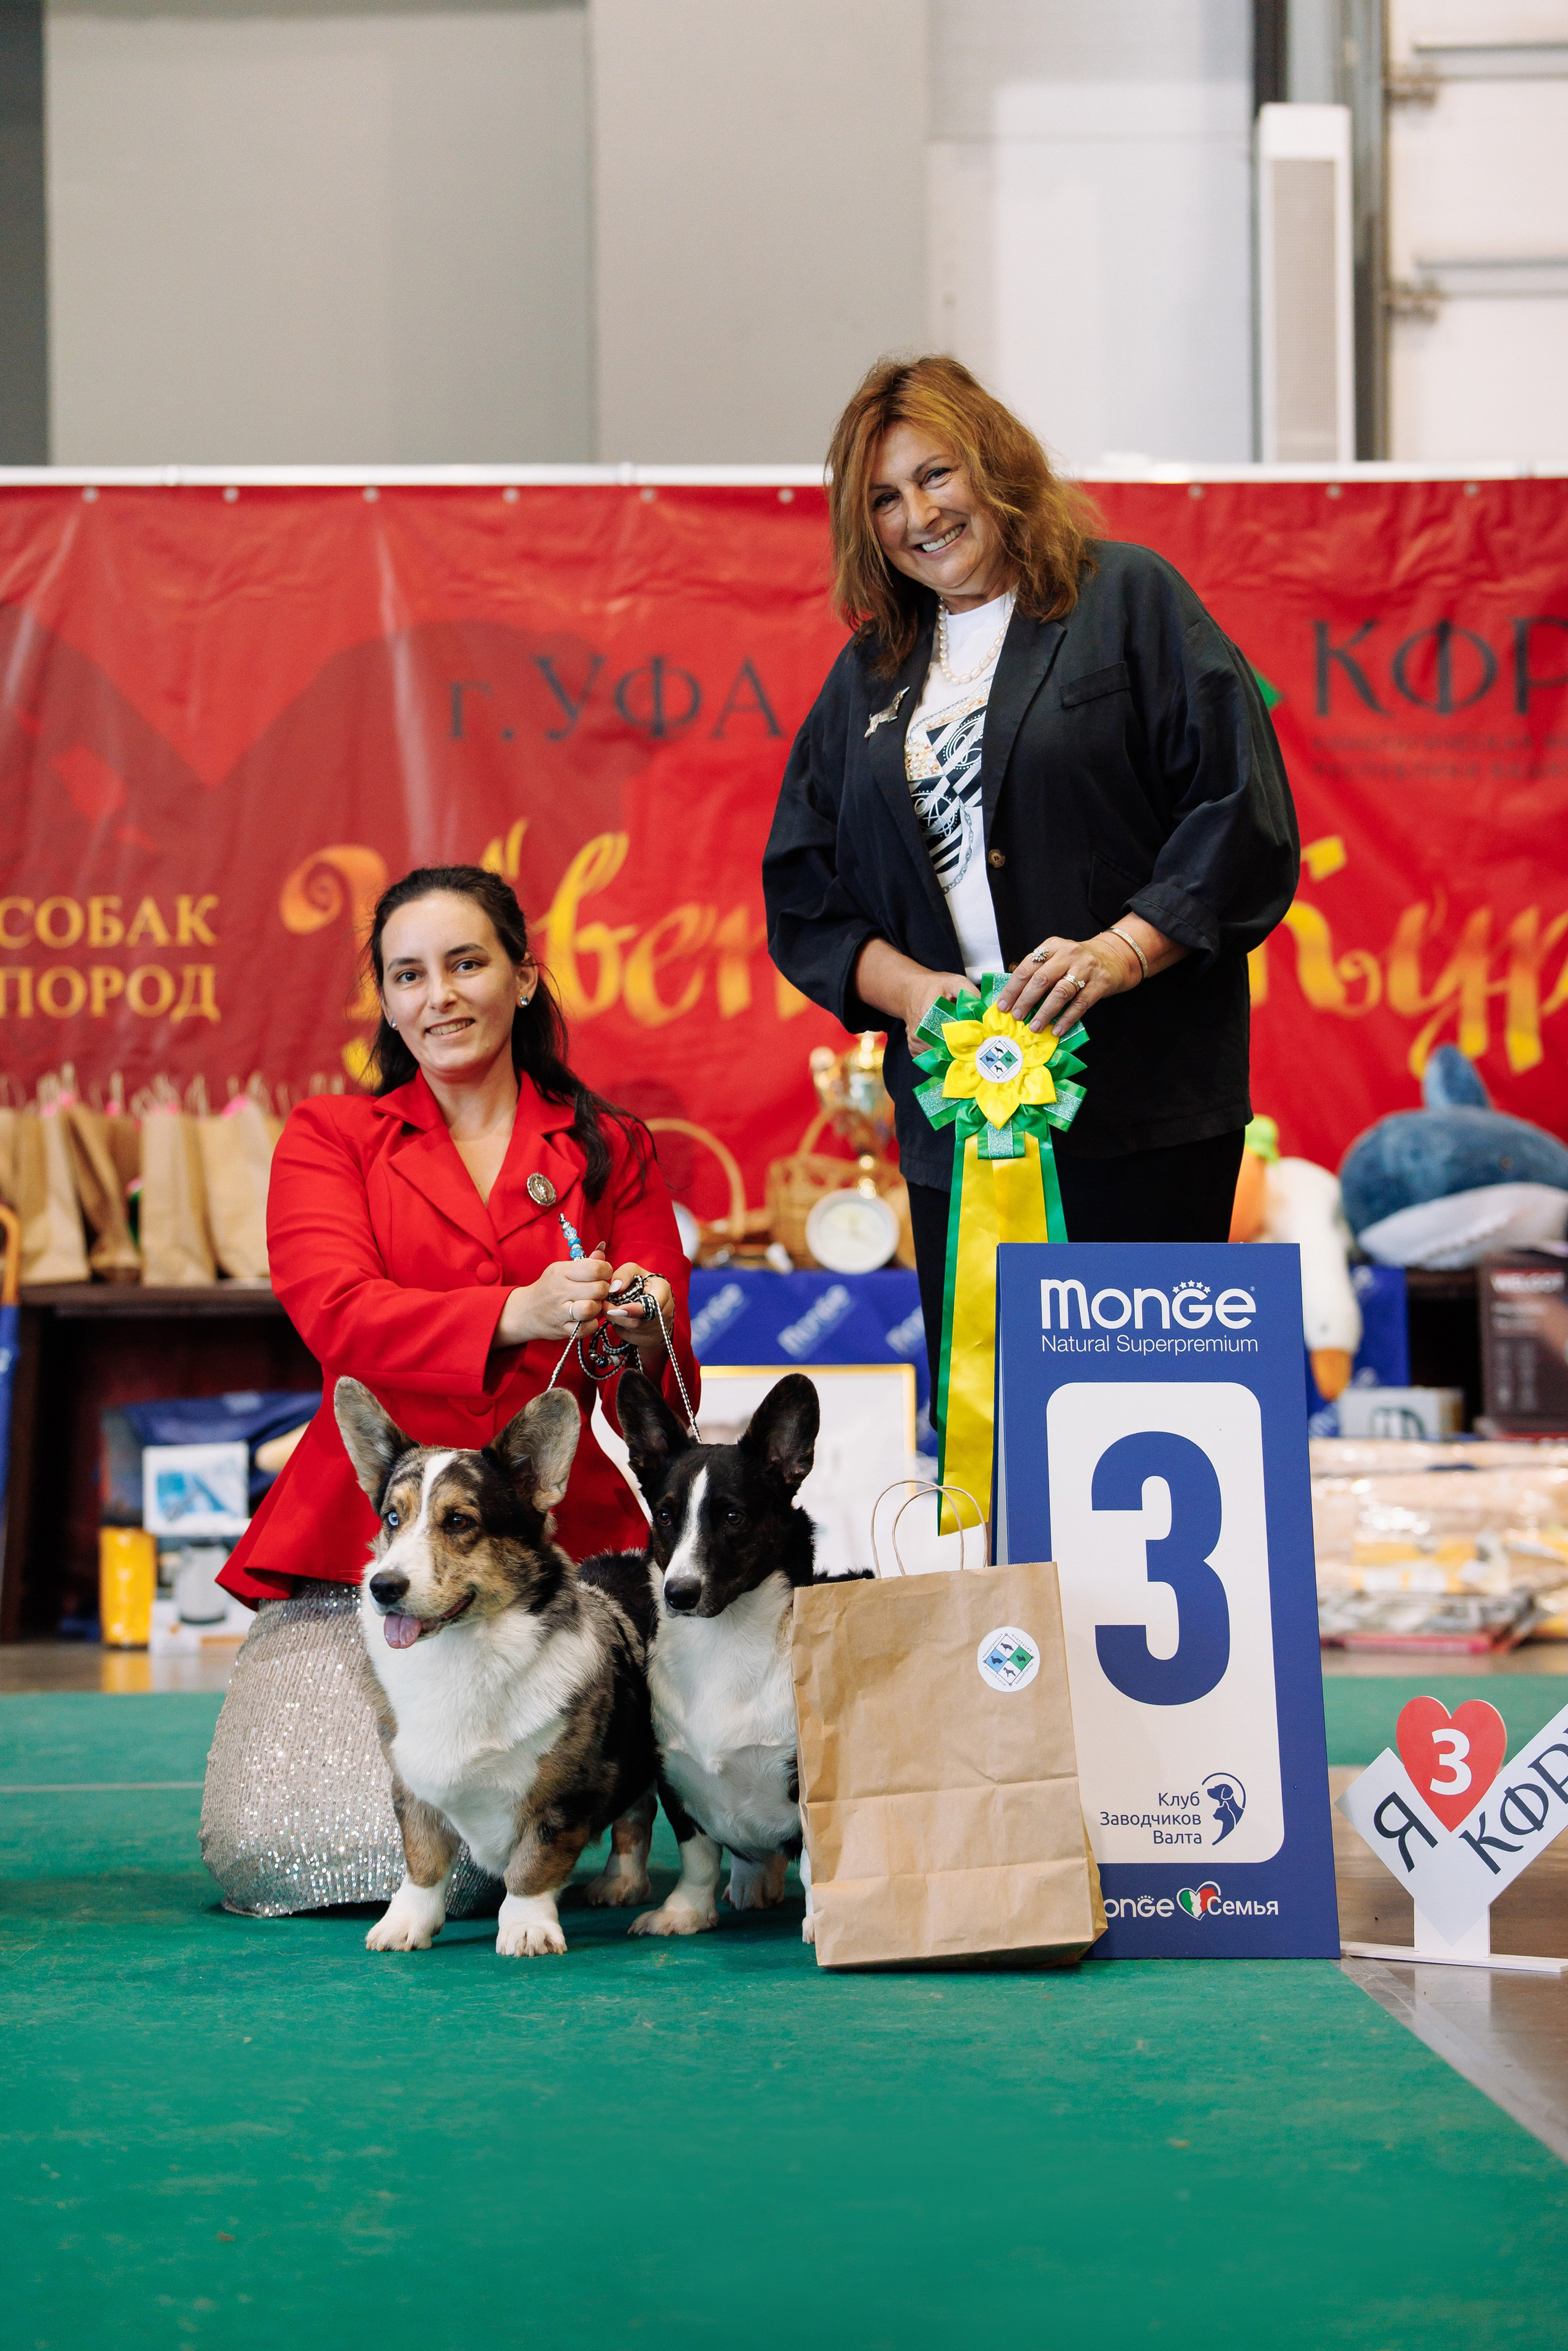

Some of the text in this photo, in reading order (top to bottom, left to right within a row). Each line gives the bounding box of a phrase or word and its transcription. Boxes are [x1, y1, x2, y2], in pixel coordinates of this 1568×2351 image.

[530, 653, 791, 740] УФА
[0, 894, 219, 949] СОБАК
[0, 964, 221, 1025] ПОРОД
[1041, 1334, 1258, 1356] Natural Superpremium
[1091, 1431, 1231, 1706] 3
[1100, 1811, 1202, 1828] Заводчиков
[1158, 1791, 1200, 1809] Клуб
[1373, 1791, 1439, 1873] Я
[1429, 1728, 1472, 1796] 3
[1153, 1830, 1202, 1844] Валта
[1102, 1895, 1279, 1918] onge Семья
